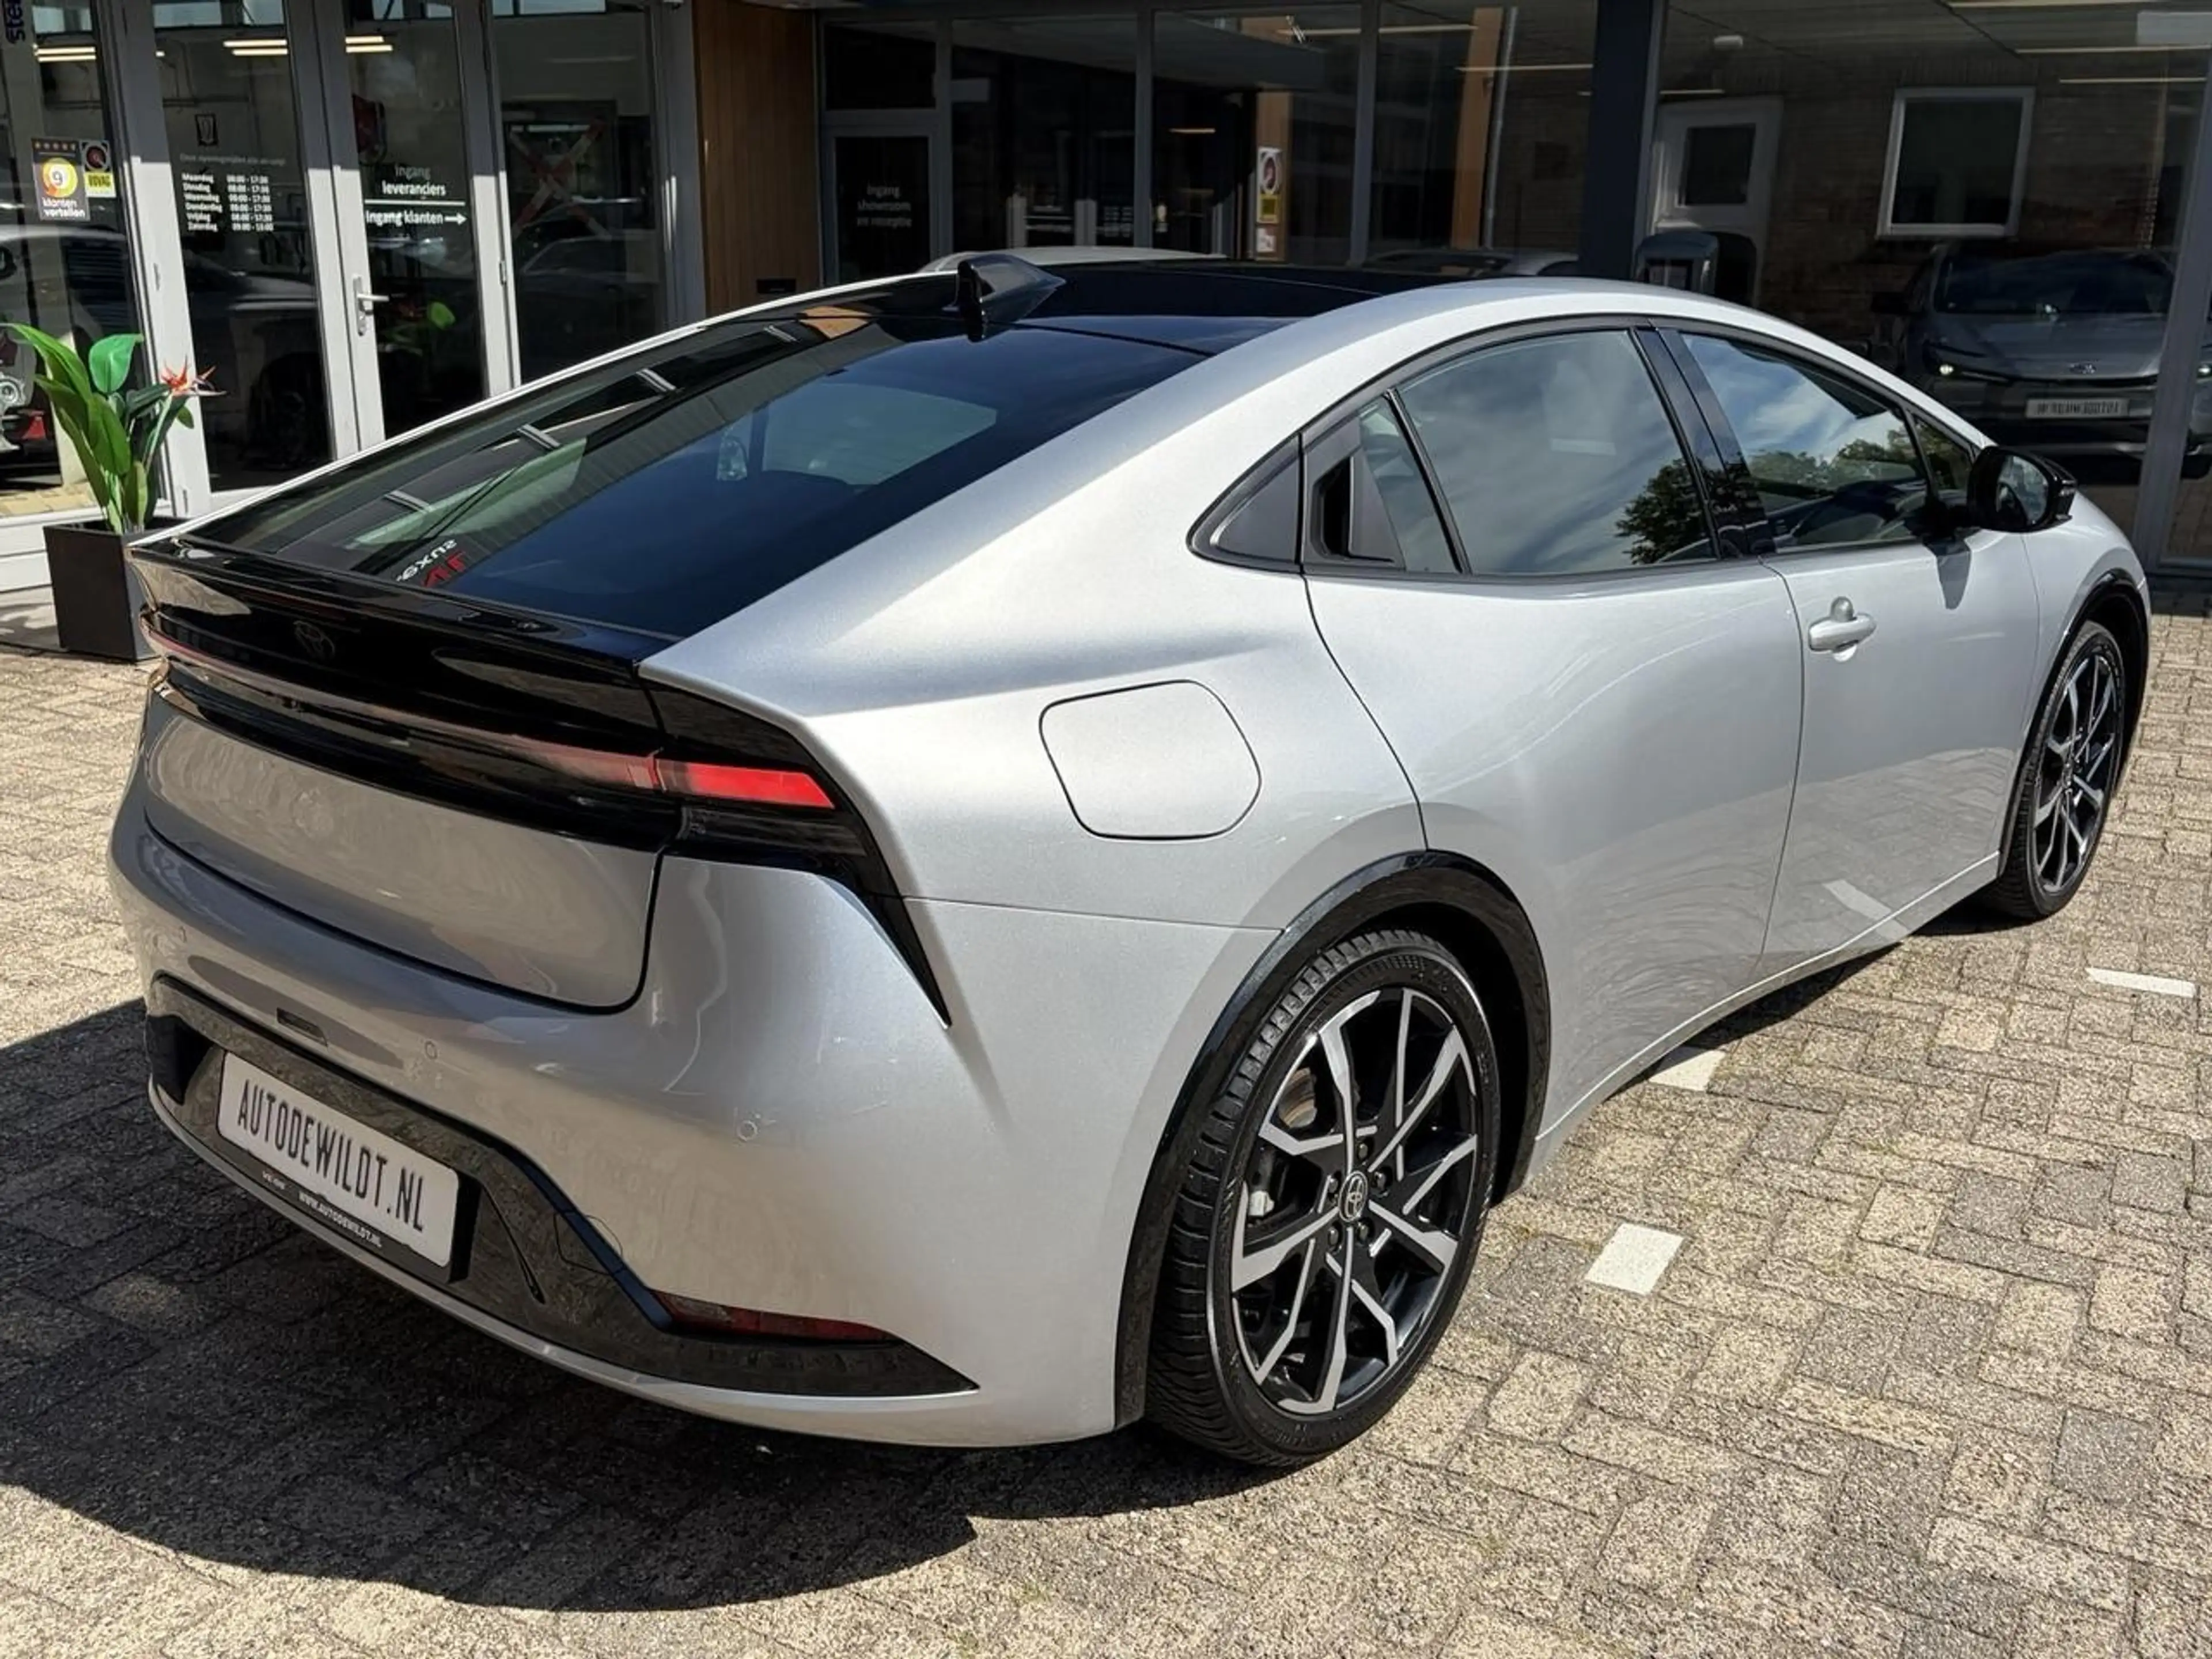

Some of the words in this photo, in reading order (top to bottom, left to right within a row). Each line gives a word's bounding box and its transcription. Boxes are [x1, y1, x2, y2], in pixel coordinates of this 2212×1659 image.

[381, 180, 446, 196] leveranciers
[404, 210, 443, 224] klanten
[237, 1079, 423, 1232] AUTODEWILDT.NL
